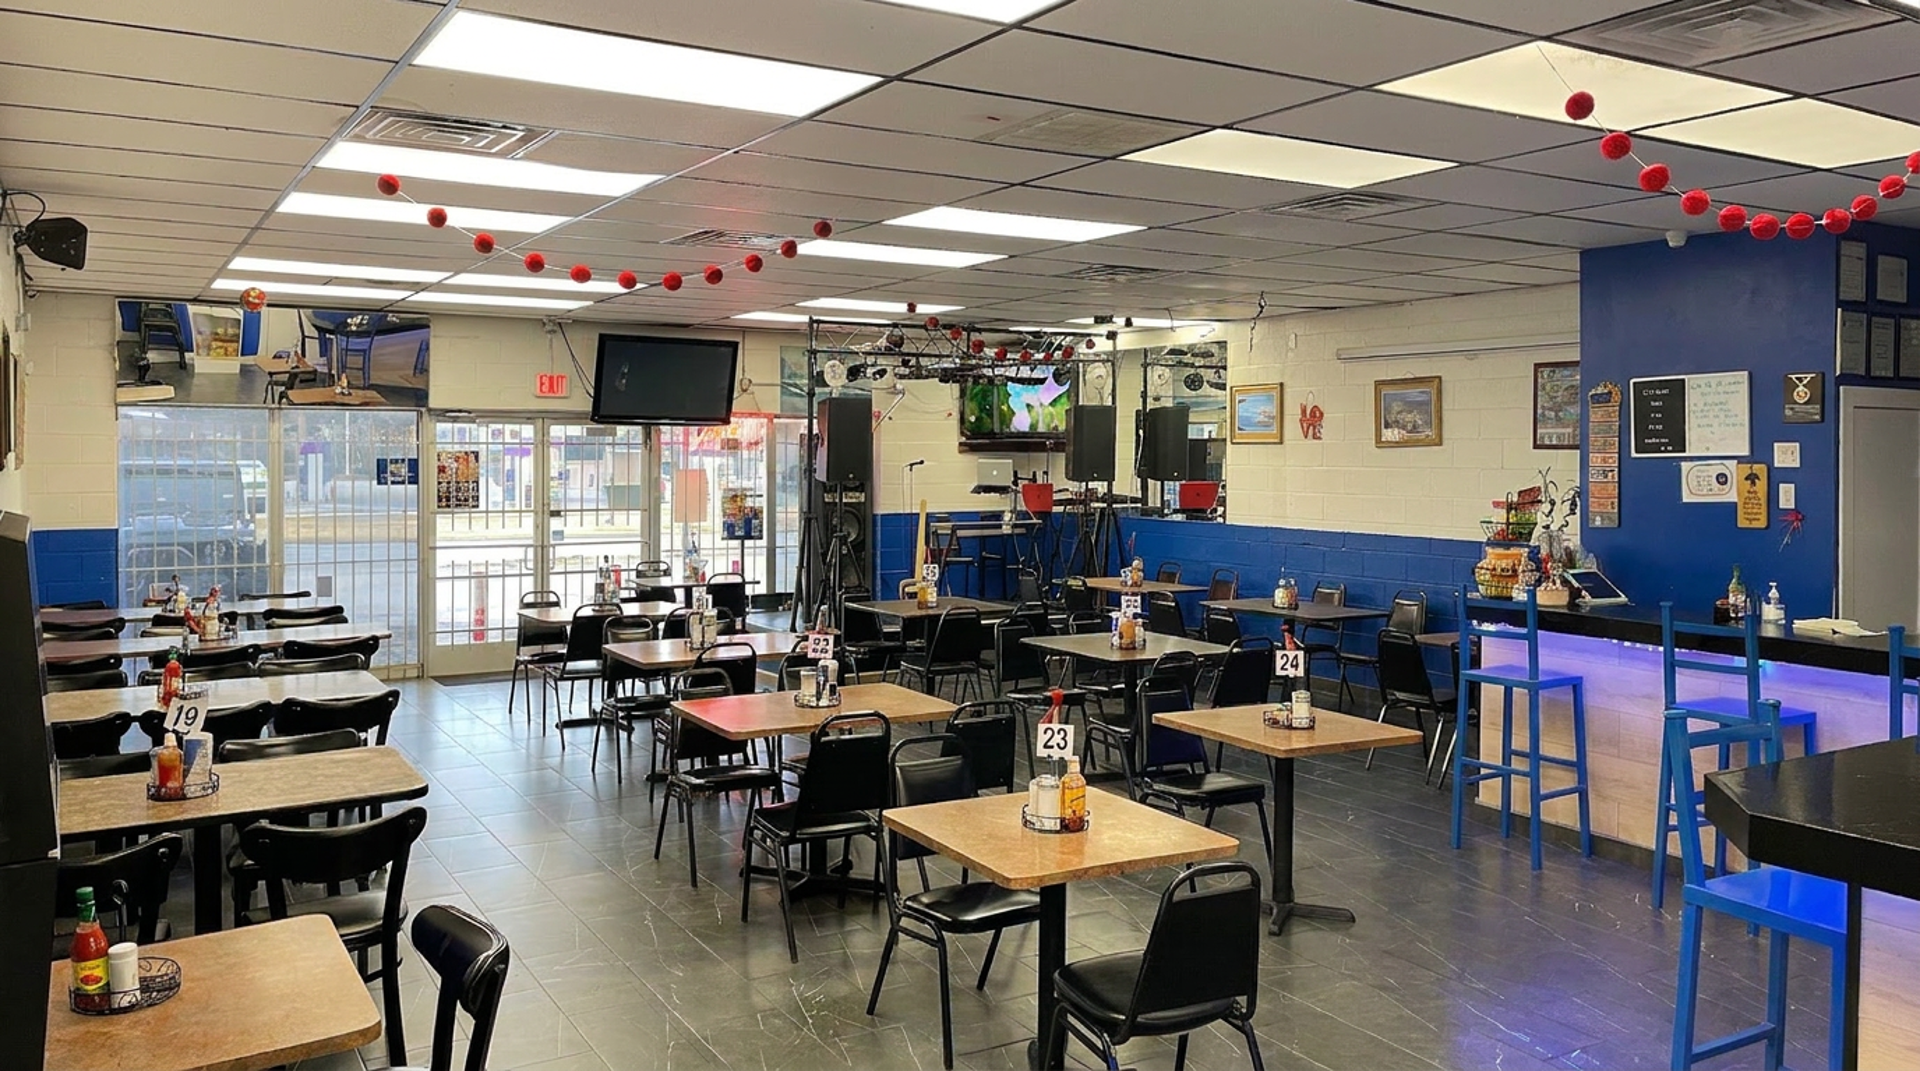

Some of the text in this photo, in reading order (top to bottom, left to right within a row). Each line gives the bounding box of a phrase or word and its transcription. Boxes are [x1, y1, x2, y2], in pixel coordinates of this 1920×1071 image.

[539, 374, 567, 394] EXIT
[1280, 653, 1299, 672] 24
[173, 704, 199, 727] 19
[1043, 727, 1068, 750] 23
